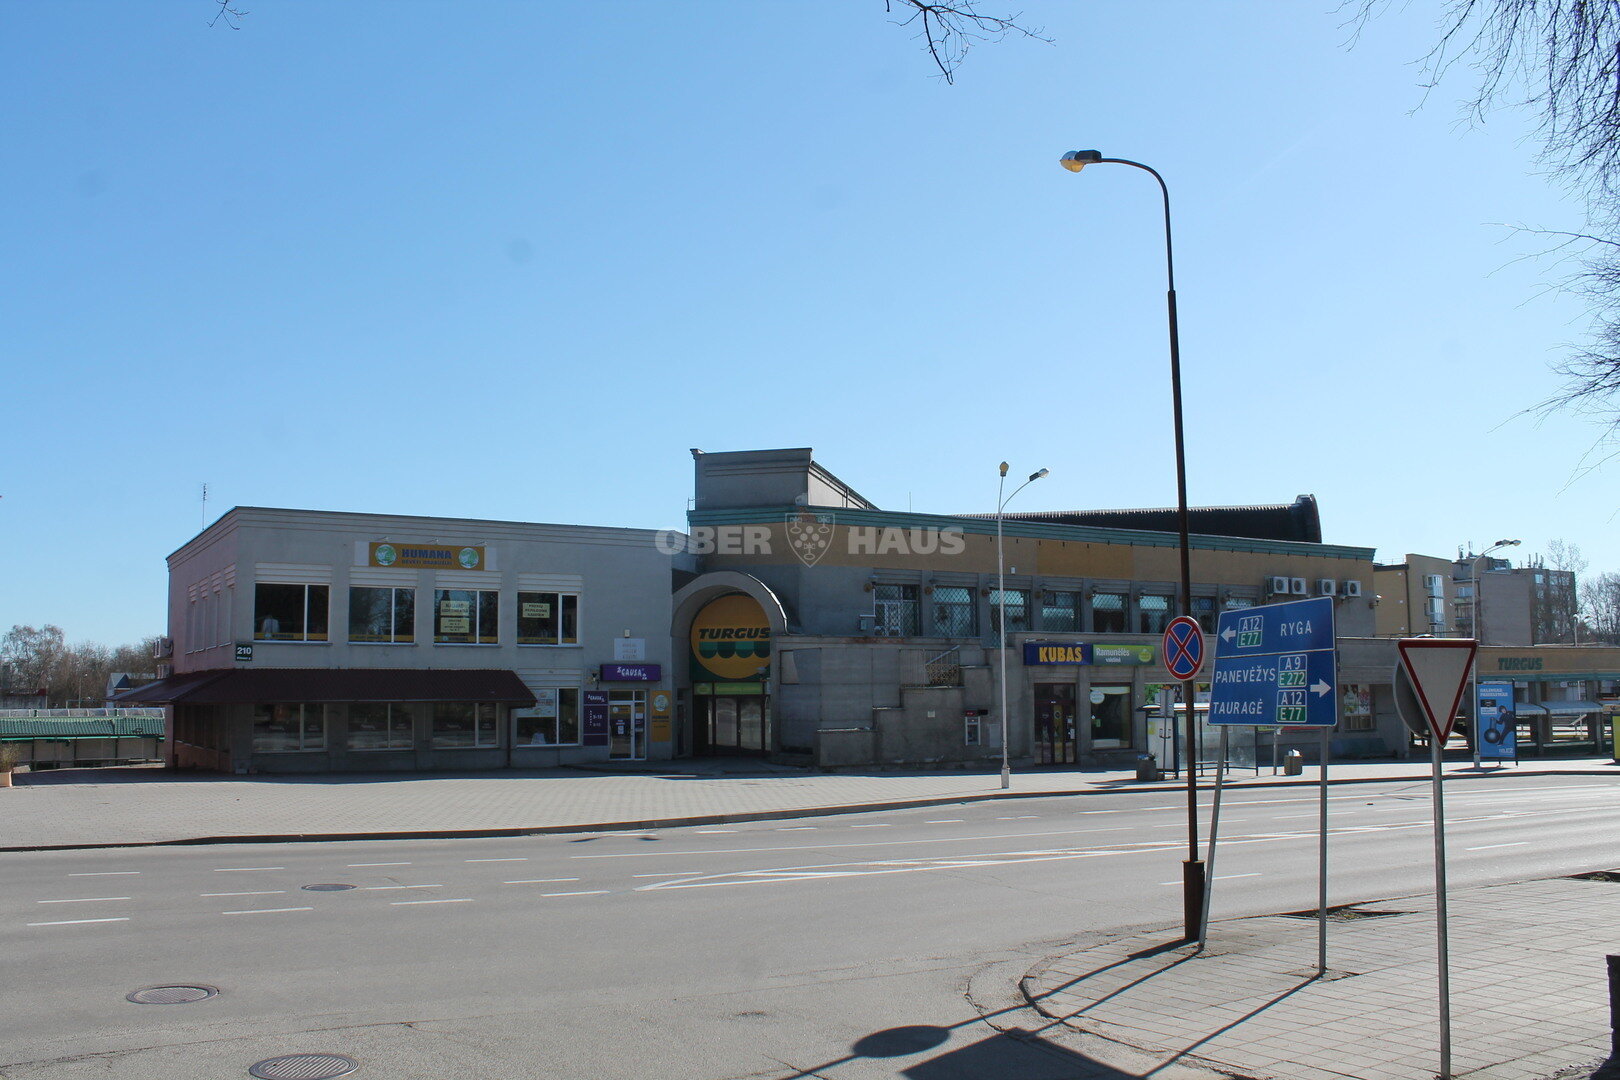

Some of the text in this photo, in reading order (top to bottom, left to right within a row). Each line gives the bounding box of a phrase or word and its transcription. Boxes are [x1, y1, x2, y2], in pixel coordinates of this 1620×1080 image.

[401, 548, 453, 560] HUMANA
[698, 626, 771, 640] TURGUS
[1280, 619, 1313, 637] RYGA
[236, 646, 253, 656] 210
[1038, 646, 1083, 663] KUBAS
[1497, 657, 1543, 671] TURGUS
[1215, 665, 1276, 684] PANEVĖŽYS
[1213, 698, 1264, 715] TAURAGĖ
